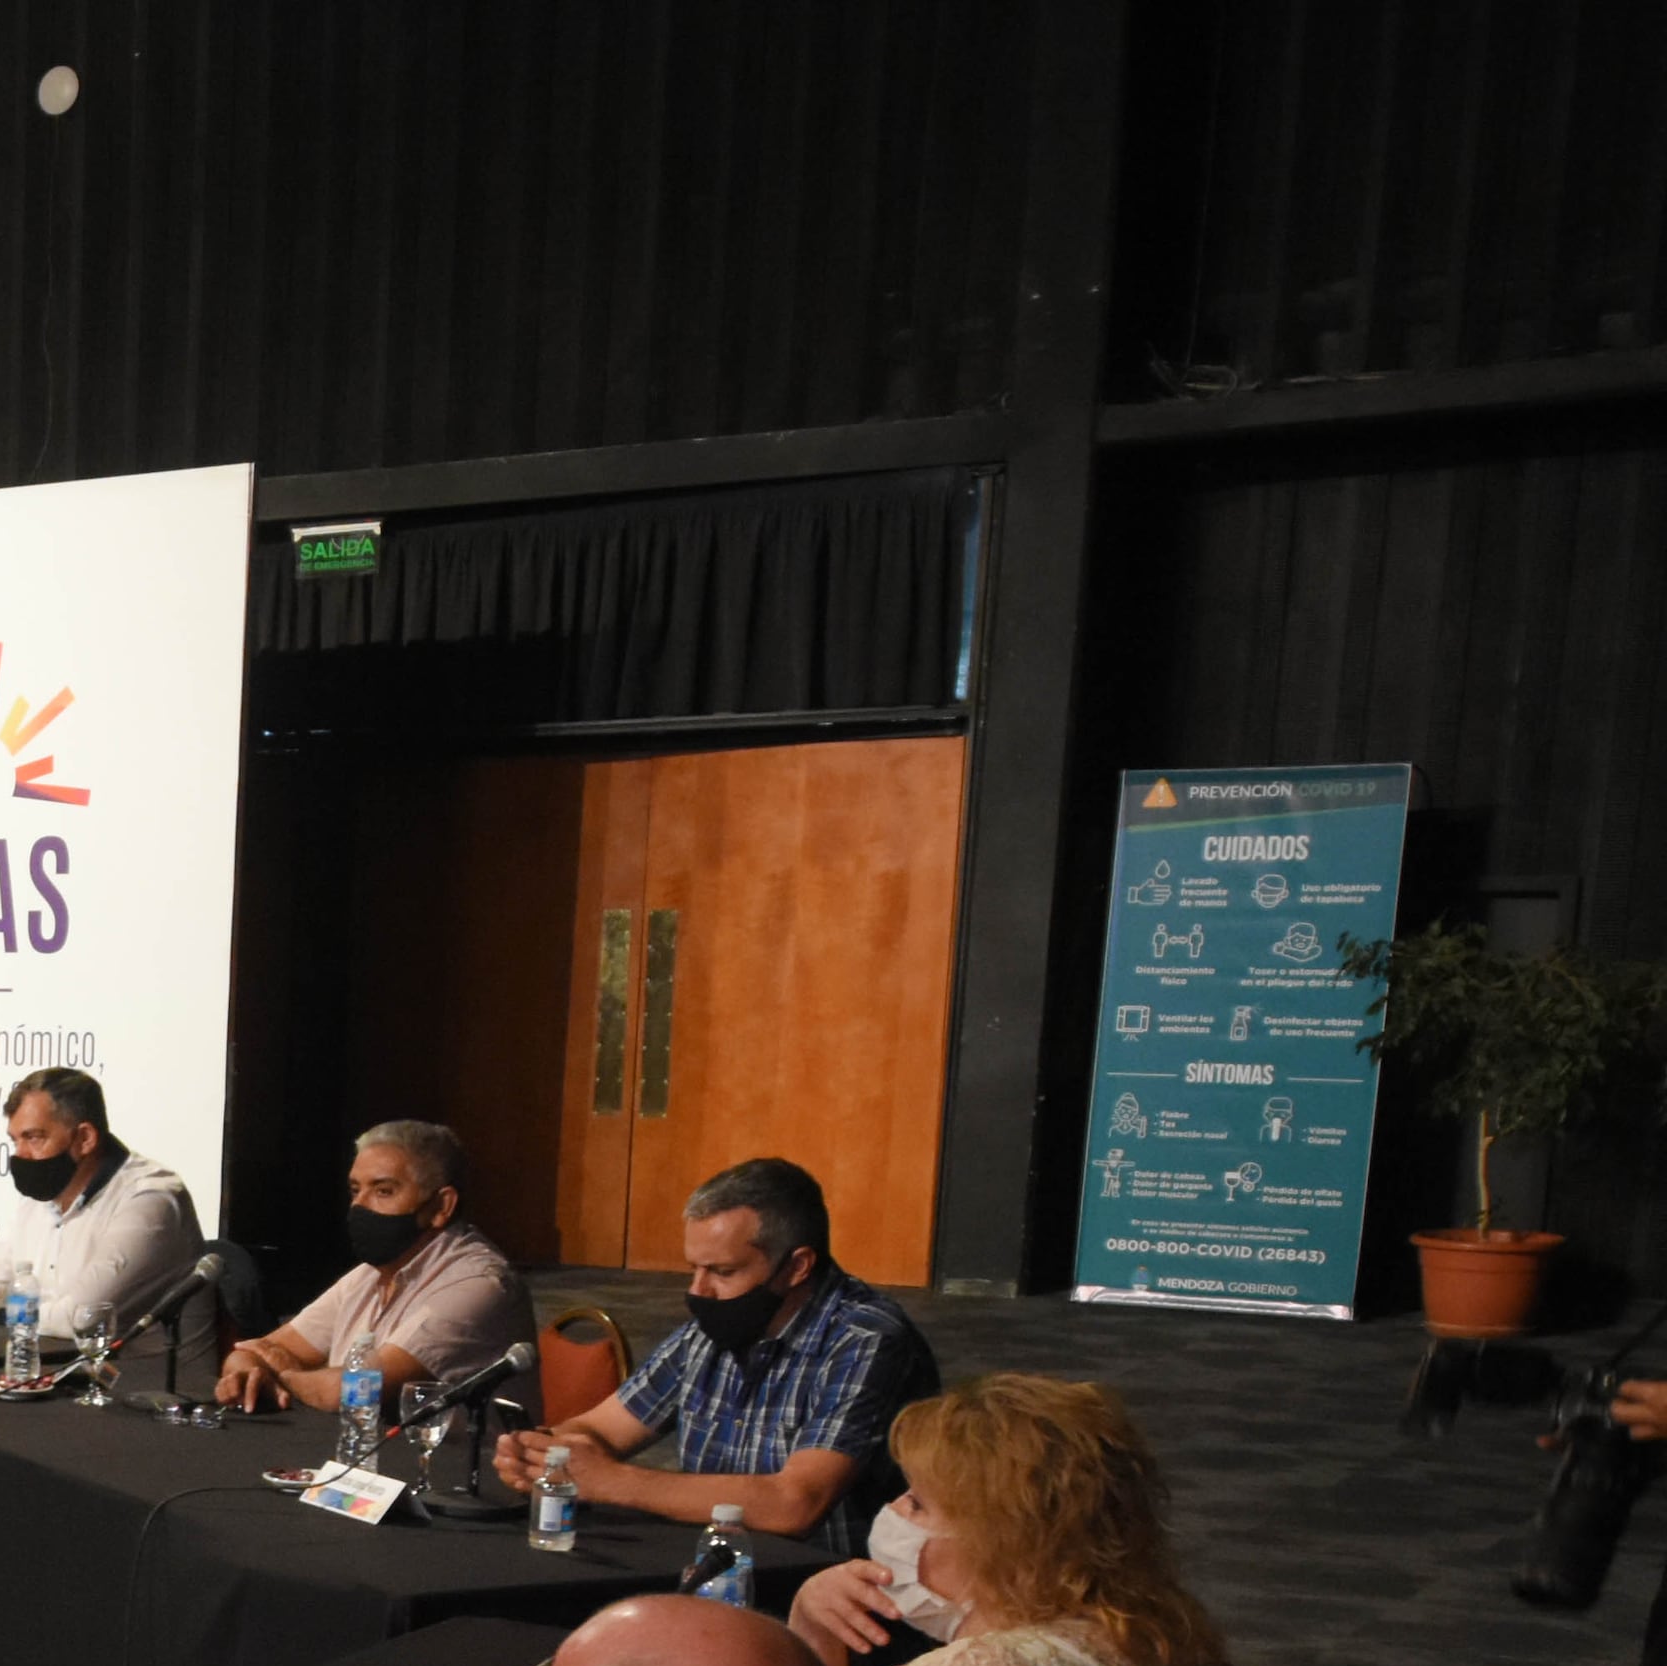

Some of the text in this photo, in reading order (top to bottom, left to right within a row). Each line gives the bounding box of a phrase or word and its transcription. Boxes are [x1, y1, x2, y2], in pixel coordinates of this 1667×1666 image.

[299, 537, 375, 561] SALIDA
[1189, 781, 1292, 799] PREVENCIÓN
[1298, 783, 1353, 797] COVID
[1203, 835, 1310, 862] CUIDADOS
[1185, 1059, 1274, 1085] SÍNTOMAS
[1106, 1238, 1327, 1265] 0800-800-COVID (26843)
[1157, 1277, 1298, 1297] MENDOZA GOBIERNO
